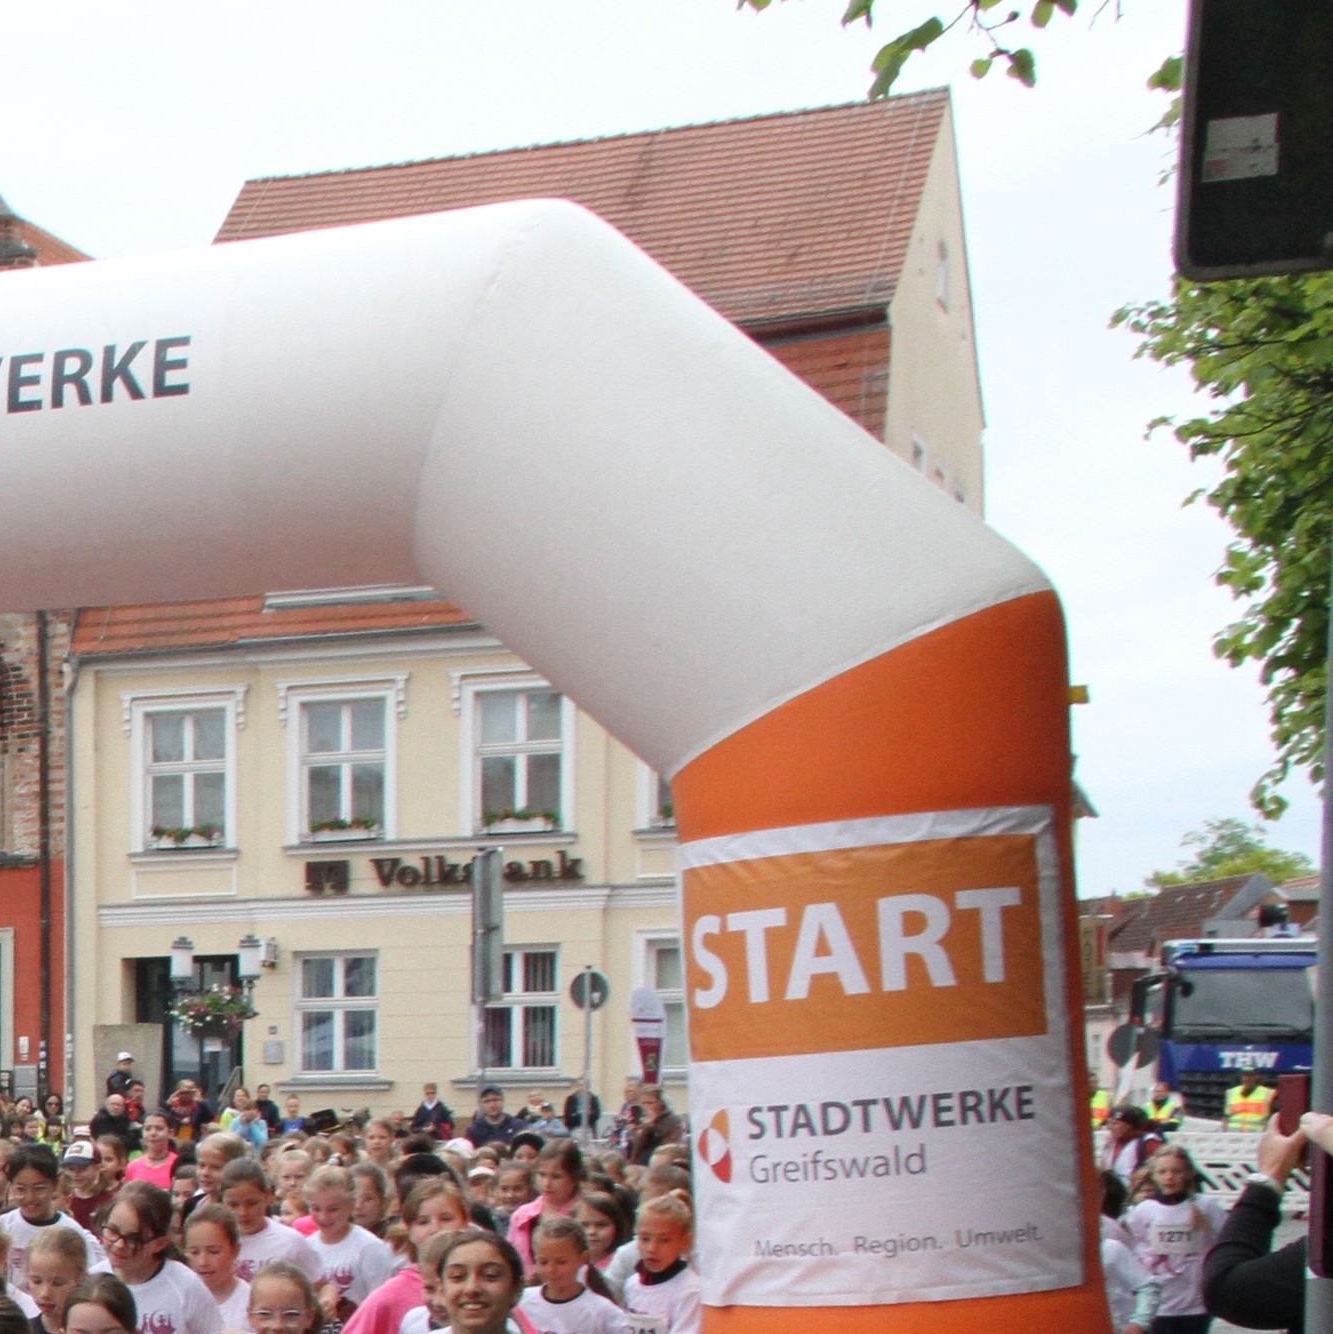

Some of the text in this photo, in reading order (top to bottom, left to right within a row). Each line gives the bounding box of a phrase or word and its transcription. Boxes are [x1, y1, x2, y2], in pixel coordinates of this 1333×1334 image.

[370, 850, 585, 887] Volksank
[691, 886, 1022, 1010] START
[1218, 1051, 1280, 1069] THW
[747, 1085, 1036, 1140] STADTWERKE
[749, 1143, 927, 1184] Greifswald
[755, 1222, 1044, 1259] Mensch. Region. Umwelt.
[1158, 1230, 1192, 1243] 1271
